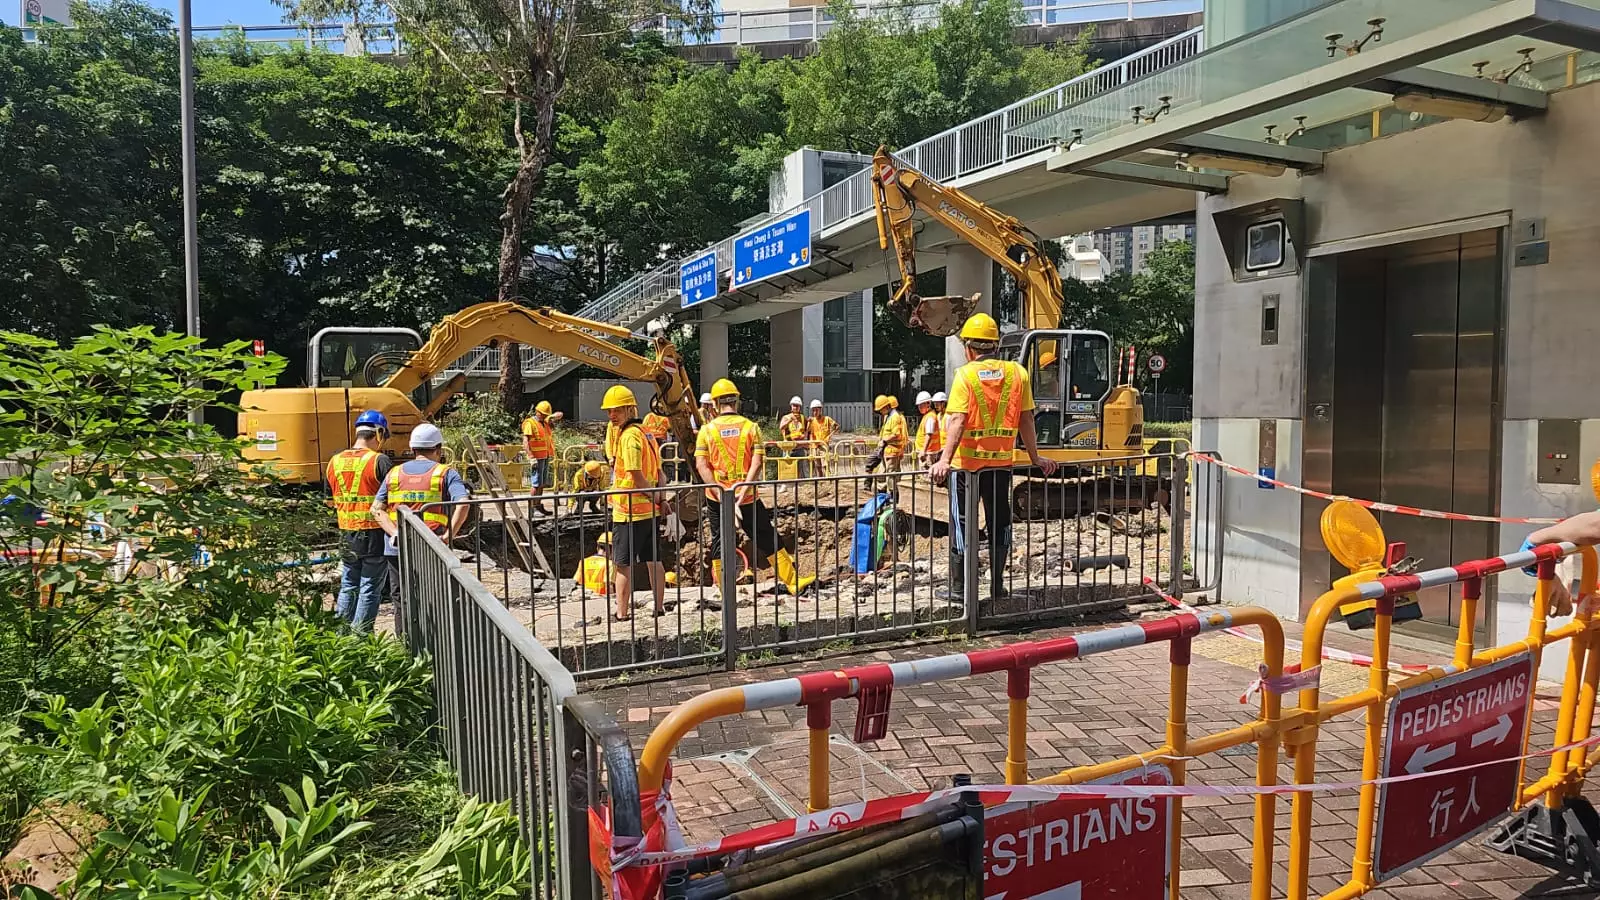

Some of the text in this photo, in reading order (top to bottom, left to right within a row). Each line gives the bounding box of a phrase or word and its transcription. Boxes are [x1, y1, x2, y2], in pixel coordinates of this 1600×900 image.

[786, 222, 796, 232] Wan
[939, 200, 977, 229] KATO
[1529, 222, 1535, 236] 1
[578, 344, 621, 366] KATO
[1151, 359, 1163, 368] 50
[1399, 672, 1526, 741] PEDESTRIANS
[1429, 775, 1481, 838] 行人
[984, 796, 1156, 880] STRIANS
